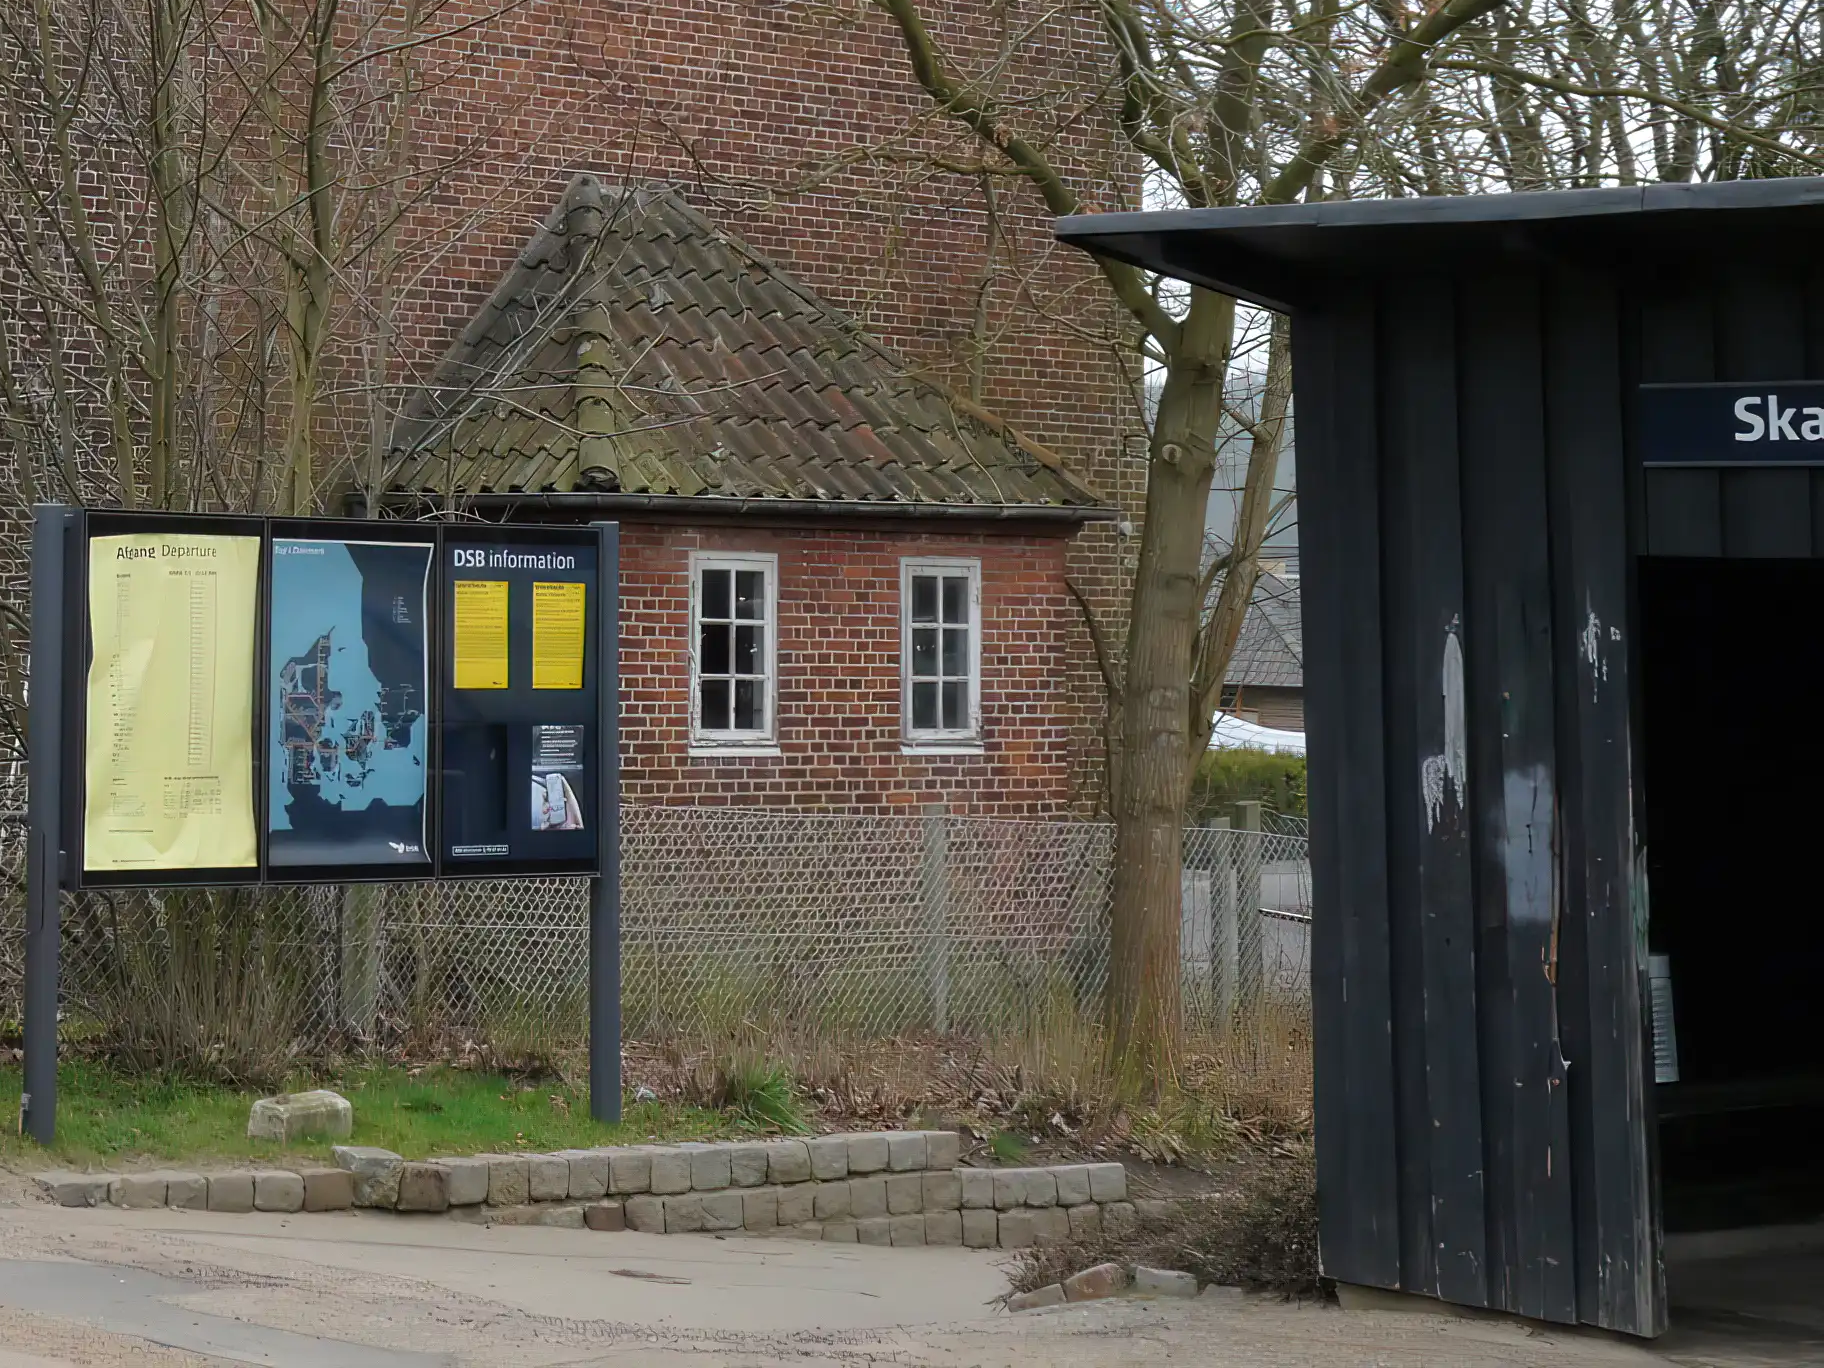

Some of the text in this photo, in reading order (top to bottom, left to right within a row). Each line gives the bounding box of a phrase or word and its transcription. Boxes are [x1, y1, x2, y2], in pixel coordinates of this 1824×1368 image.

[1733, 394, 1824, 442] Ska
[161, 544, 217, 559] Departure
[453, 549, 575, 570] DSB information
